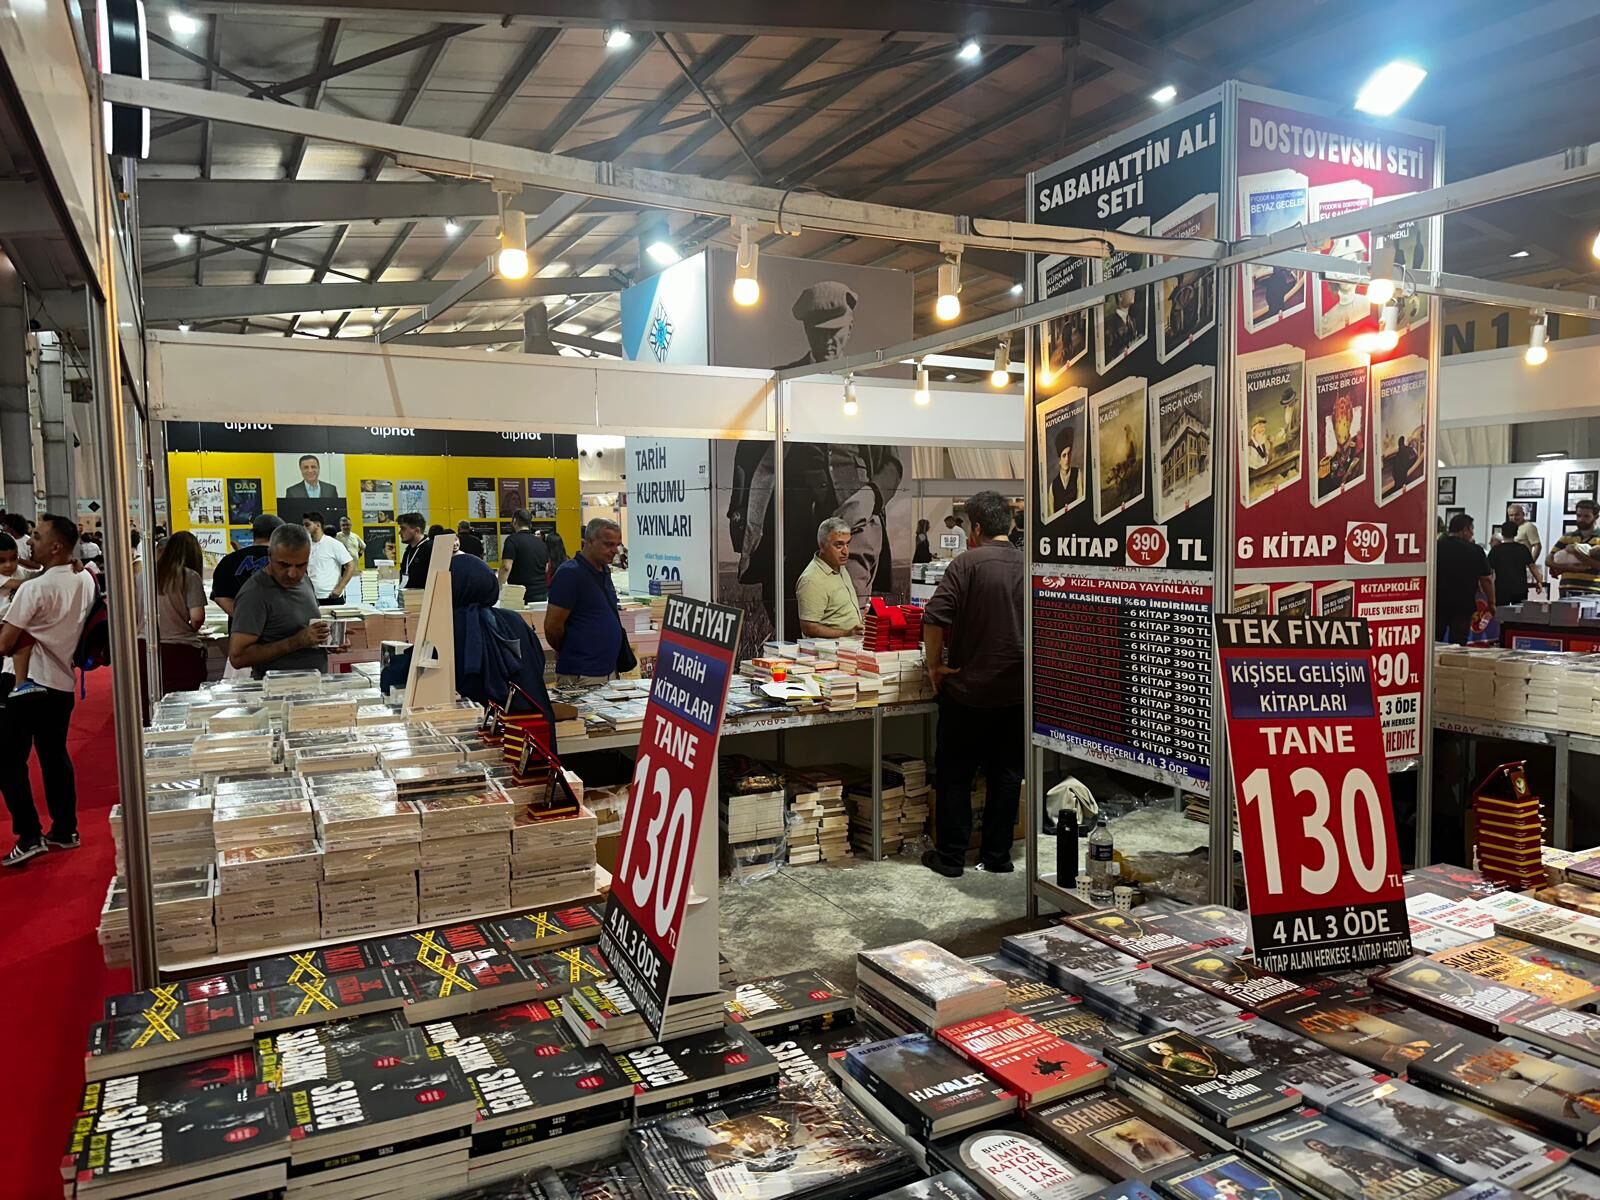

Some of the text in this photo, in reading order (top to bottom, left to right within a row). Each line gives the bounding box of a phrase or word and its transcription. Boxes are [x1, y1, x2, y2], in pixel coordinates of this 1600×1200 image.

[1250, 118, 1424, 179] DOSTOYEVSKİ SETİ
[1040, 113, 1216, 212] SABAHATTİN ALİ
[1097, 175, 1144, 219] SETİ
[1251, 201, 1274, 214] BEYAZ
[1276, 198, 1306, 211] GECELER
[1047, 264, 1062, 285] KÜRK
[1048, 274, 1074, 296] MADONNA
[1248, 374, 1290, 393] KUMARBAZ
[1318, 382, 1339, 394] TATSIZ
[1340, 378, 1350, 390] BİR
[1350, 375, 1366, 387] OLAY
[1382, 386, 1400, 398] BEYAZ
[1160, 399, 1182, 417] SIRÇA
[1183, 390, 1202, 408] KÖŞK
[1046, 410, 1071, 428] KUYUCAKLI
[1100, 408, 1120, 424] KAĞNI
[636, 443, 666, 471] TARİH
[637, 480, 685, 503] KURUMU
[637, 514, 691, 536] YAYINLARI
[1040, 534, 1207, 561] 6 KİTAP TL
[1132, 534, 1160, 551] 390
[1238, 532, 1419, 559] 6 KİTAP TL
[1352, 529, 1379, 548] 390
[1141, 552, 1150, 560] TL
[1360, 548, 1370, 558] TL
[1071, 579, 1203, 595] KIZIL PANDA YAYINLARI
[1360, 581, 1420, 593] KİTAPKOLİK
[1039, 590, 1067, 600] DÜNYA
[1070, 592, 1121, 604] KLASİKLERİ
[1124, 598, 1146, 607] %60
[1150, 599, 1208, 613] İNDİRİMLE
[1360, 602, 1419, 616] JULES VERNE SETİ
[667, 600, 736, 643] TEK FİYAT
[1129, 608, 1210, 624] 6 KİTAP 390 TL
[1139, 620, 1170, 632] KİTAP
[1172, 625, 1194, 634] 390
[1196, 627, 1210, 636] TL
[1222, 615, 1361, 645] TEK FİYAT
[1378, 624, 1420, 647] KİTAP
[1139, 631, 1169, 643] KİTAP
[1172, 636, 1194, 646] 390
[1196, 639, 1210, 648] TL
[1130, 642, 1211, 660] 6 KİTAP 390 TL
[1130, 652, 1210, 672] 6 KİTAP 390 TL
[672, 651, 707, 684] TARİH
[1131, 663, 1211, 683] 6 KİTAP 390 TL
[1232, 661, 1366, 687] KİŞİSEL GELİŞİM
[1131, 674, 1211, 695] 6 KİTAP 390 TL
[1410, 674, 1419, 684] TL
[654, 677, 713, 725] KİTAPLARI
[1130, 695, 1211, 718] 6 KİTAP 390 TL
[1131, 685, 1211, 707] 6 KİTAP 390 TL
[1260, 691, 1346, 712] KİTAPLARI
[1386, 697, 1416, 715] 3 ÖDE
[1391, 717, 1415, 727] HERKESE
[654, 715, 699, 769] TANE
[1260, 726, 1355, 755] TANE
[1386, 729, 1415, 752] HEDİYE
[1050, 730, 1188, 776] TÜM SETLERDE 4 AL 3 ÖDE
[1242, 767, 1402, 895] 130 TL
[620, 754, 693, 938] 130
[668, 928, 676, 949] TL
[1273, 921, 1286, 944] 4
[1292, 917, 1320, 943] AL
[1325, 915, 1338, 938] 3
[1344, 907, 1390, 936] ÖDE
[610, 907, 661, 988] 4 AL 3 ÖDE
[1264, 949, 1287, 972] KİTAP
[1291, 952, 1313, 970] ALAN
[1314, 947, 1350, 966] HERKESE
[1382, 938, 1411, 958] HEDİYE
[962, 1023, 1041, 1053] KOMUTANLAR
[908, 1072, 989, 1102] HAYALET
[1181, 1067, 1262, 1096] Yavuz Sultan
[1218, 1083, 1262, 1100] Selim
[1052, 1098, 1134, 1134] SAFAHAT
[986, 1151, 1041, 1176] RATOR
[1017, 1159, 1051, 1175] LUK
[1028, 1167, 1064, 1183] LAR
